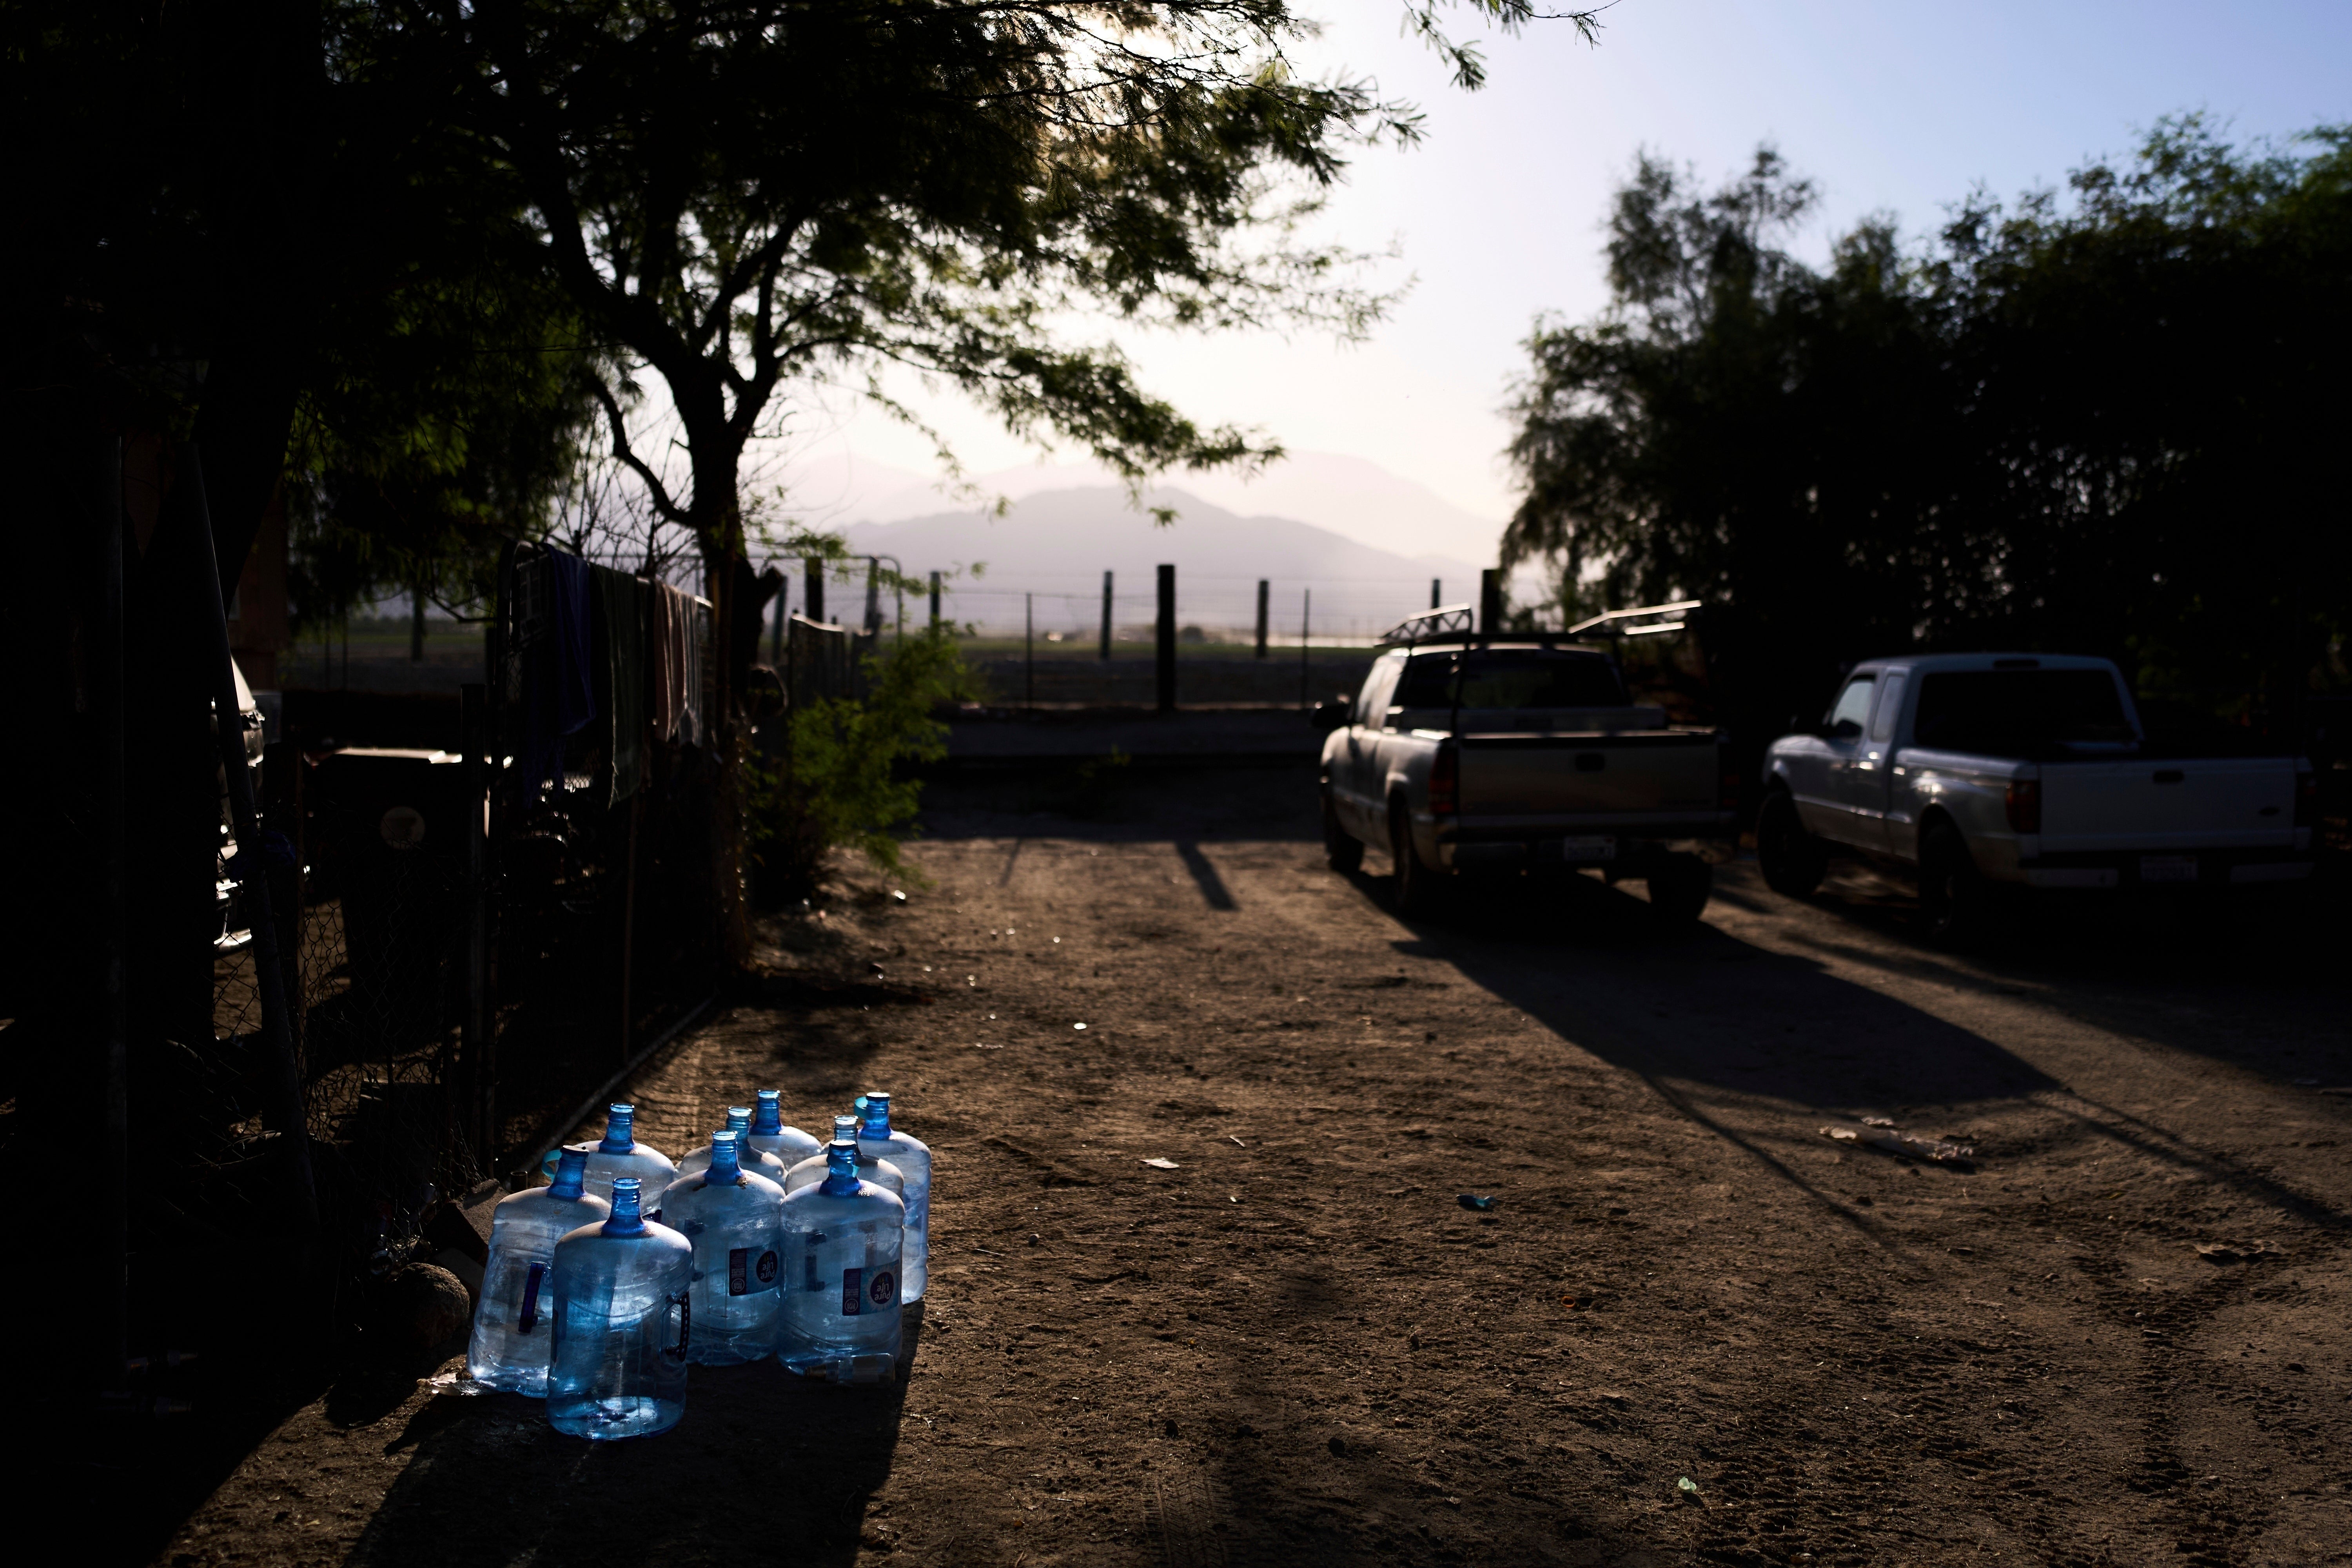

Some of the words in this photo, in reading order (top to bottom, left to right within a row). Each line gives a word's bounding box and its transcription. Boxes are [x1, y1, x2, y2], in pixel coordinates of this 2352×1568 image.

[762, 1261, 774, 1272] Life
[760, 1269, 775, 1279] Pure
[877, 1283, 889, 1293] Life
[874, 1291, 890, 1301] Pure
